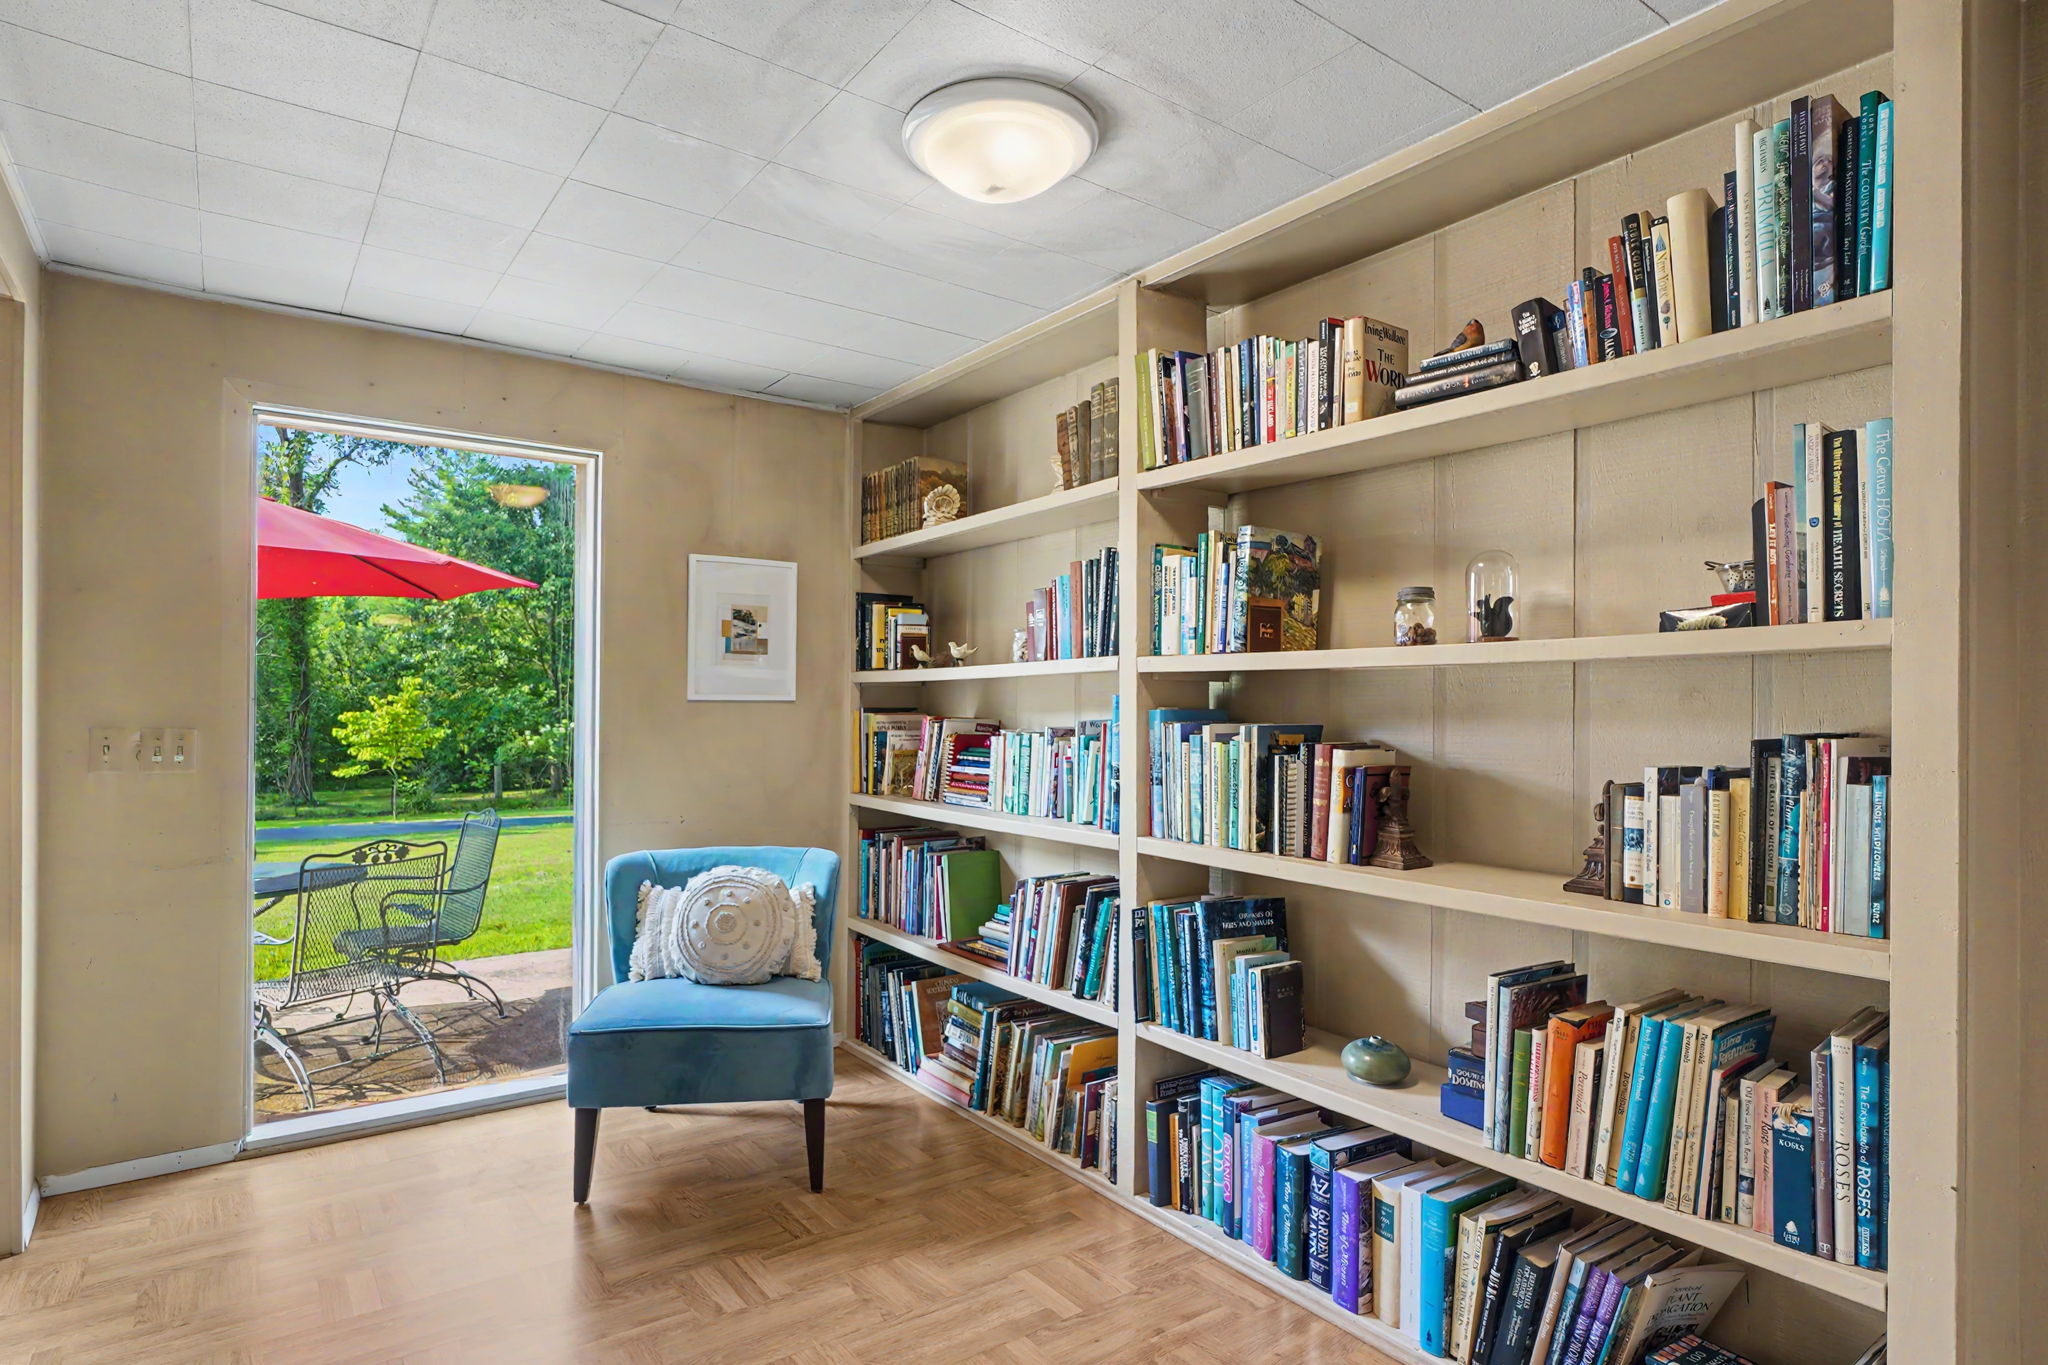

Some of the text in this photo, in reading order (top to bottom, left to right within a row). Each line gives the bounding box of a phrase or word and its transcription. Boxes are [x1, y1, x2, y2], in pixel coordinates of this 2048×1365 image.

[1861, 160, 1873, 176] The
[1860, 178, 1871, 224] COUNTRY
[1756, 182, 1774, 269] PRIMULA
[1364, 321, 1384, 341] Irving
[1365, 359, 1406, 390] WORD
[1377, 348, 1395, 366] THE
[1876, 430, 1891, 453] The
[1876, 457, 1891, 495] Genus
[1876, 498, 1891, 543] HOSTA
[1832, 530, 1844, 569] HEALTH
[1832, 572, 1845, 619] SECRETS
[1767, 833, 1775, 873] MISSOURI
[1682, 1032, 1694, 1064] Perennials
[1698, 1033, 1709, 1065] Perennials
[1575, 1070, 1589, 1116] Perennials
[1744, 1087, 1753, 1098] Old
[1860, 1085, 1871, 1099] The
[1201, 1100, 1224, 1188] FLORA
[1761, 1120, 1773, 1146] Roses
[1858, 1101, 1872, 1155] Encyclopedia
[1223, 1137, 1233, 1198] BOTANICA
[1833, 1140, 1852, 1203] ROSES
[1856, 1165, 1872, 1218] ROSES
[1309, 1205, 1318, 1256] PLANTS
[1317, 1209, 1331, 1261] GARDEN
[1472, 1226, 1485, 1271] VEGETABLES
[1340, 1245, 1349, 1288] Missouri
